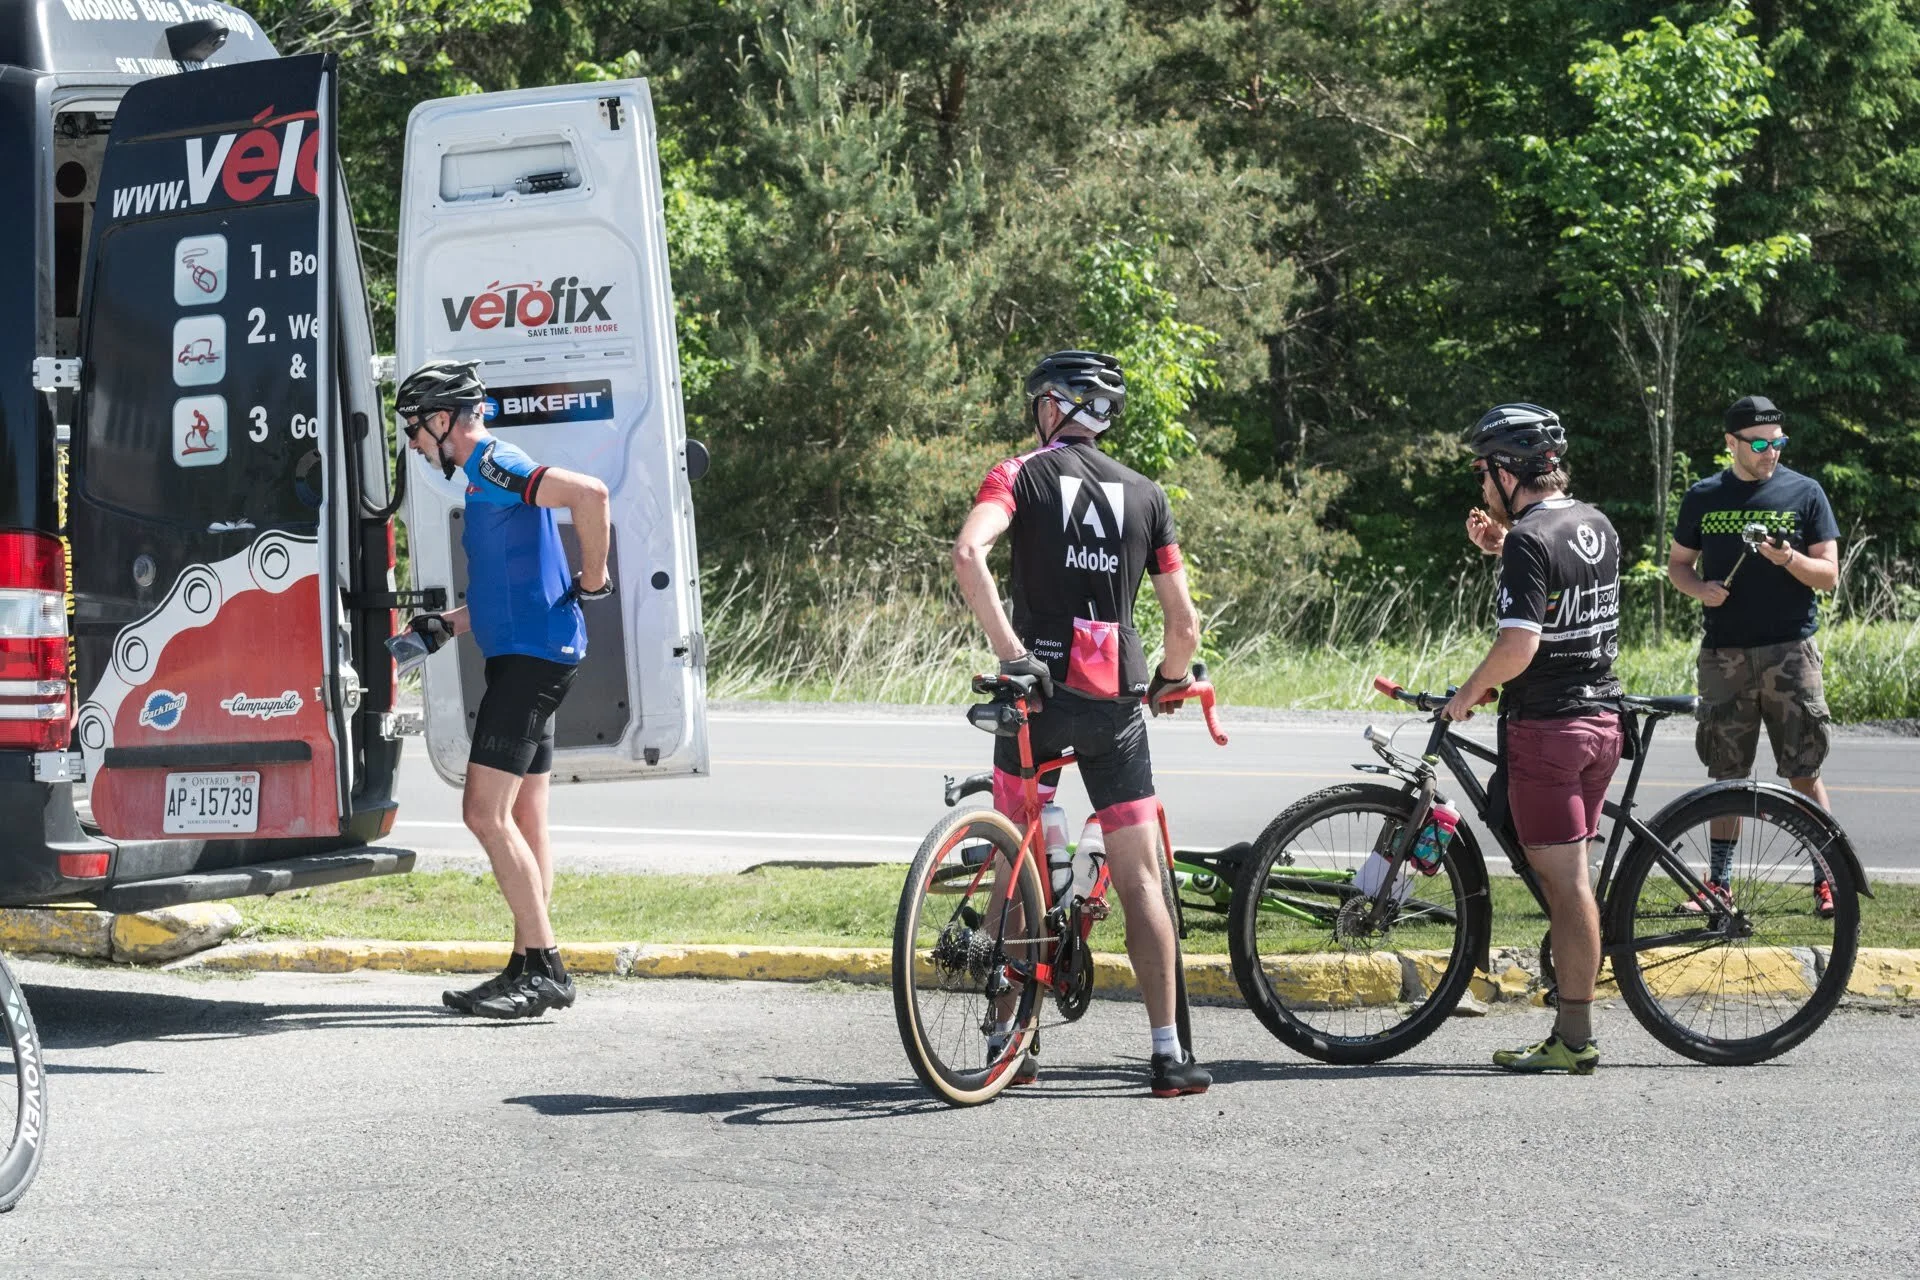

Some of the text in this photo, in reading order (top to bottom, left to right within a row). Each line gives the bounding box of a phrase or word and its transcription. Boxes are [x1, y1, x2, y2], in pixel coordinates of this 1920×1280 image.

[63, 0, 254, 41] Mobile Bike ProShop
[115, 57, 140, 74] SKI
[138, 58, 184, 75] TUNING
[251, 244, 277, 280] 1.
[247, 307, 276, 344] 2.
[527, 324, 618, 338] SAVE TIME. RIDE MORE
[290, 353, 308, 379] &
[503, 391, 602, 415] BIKEFIT
[249, 405, 269, 443] 3
[1065, 544, 1119, 573] Adobe
[1033, 648, 1064, 660] Courage
[1035, 638, 1062, 648] Passion
[231, 694, 299, 717] Campagnolo
[18, 1032, 41, 1148] WOVEN
